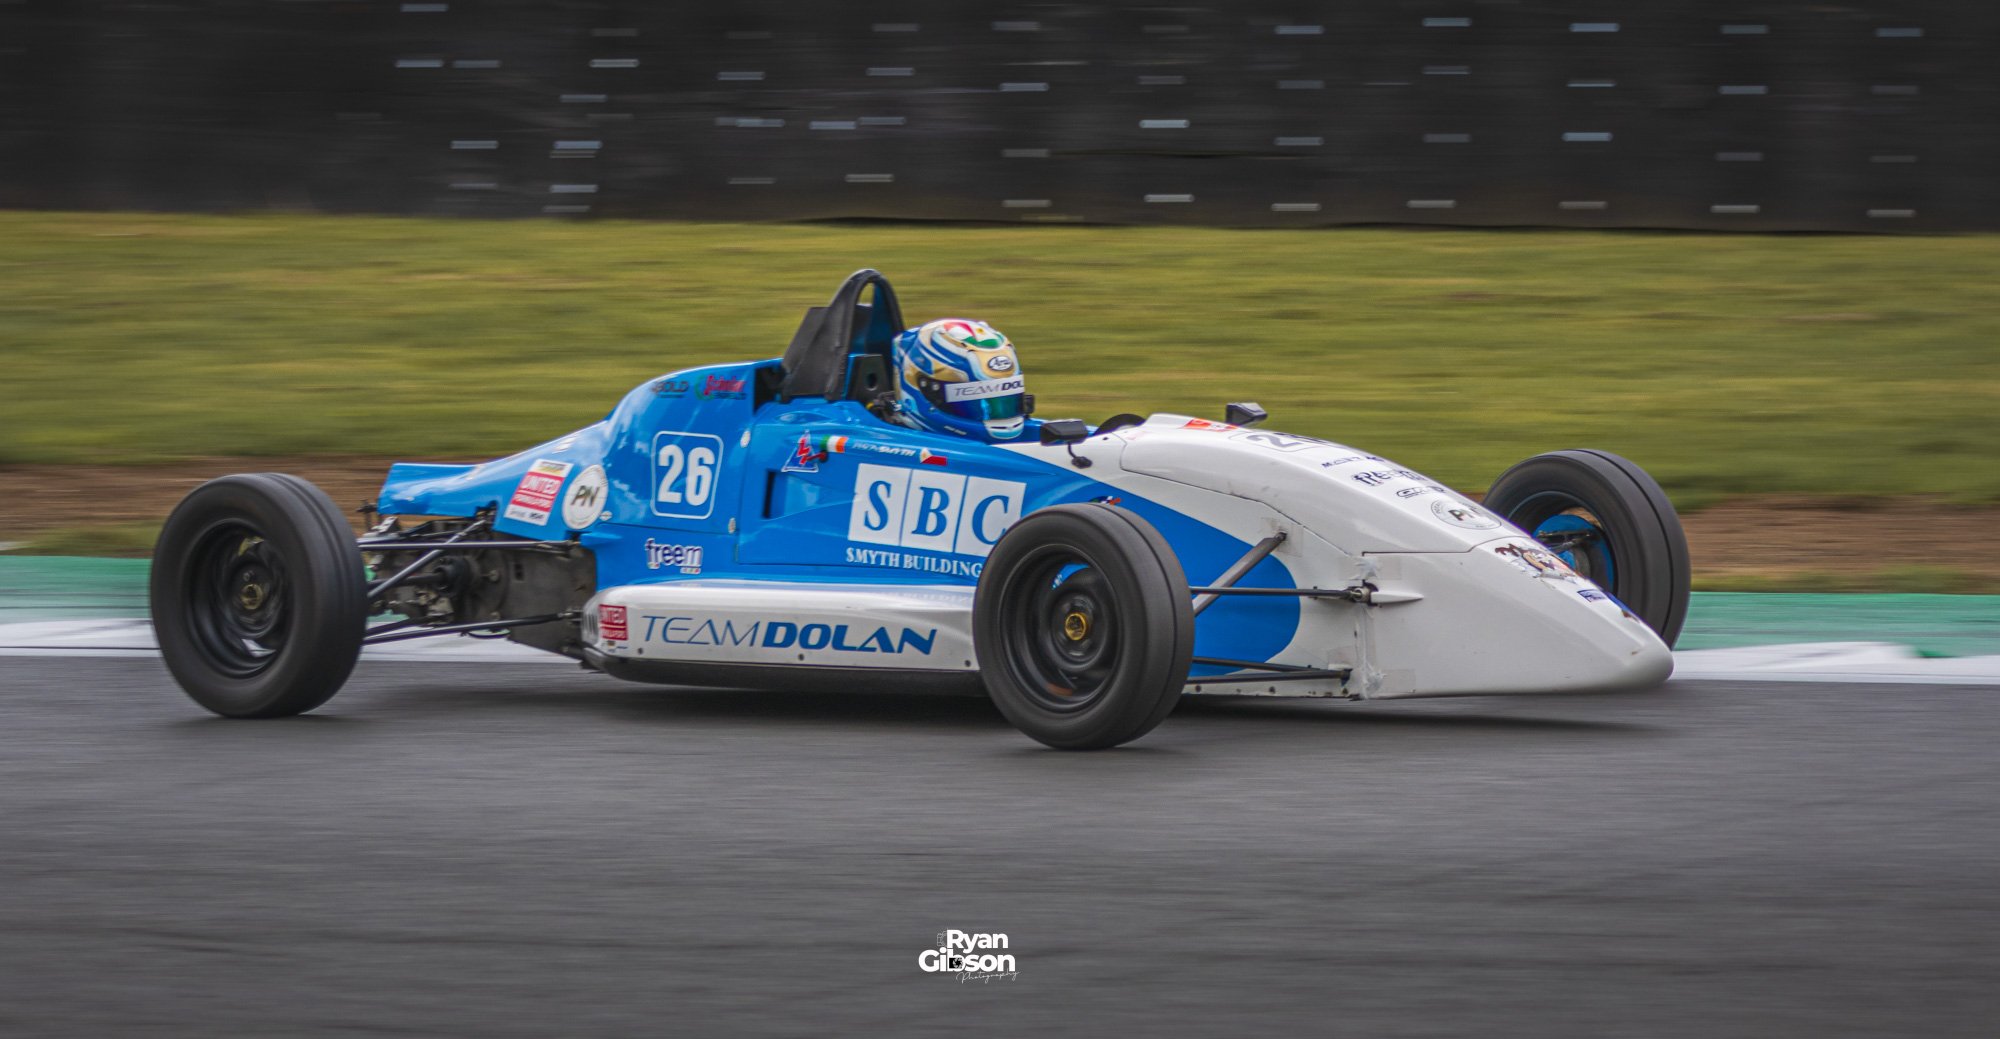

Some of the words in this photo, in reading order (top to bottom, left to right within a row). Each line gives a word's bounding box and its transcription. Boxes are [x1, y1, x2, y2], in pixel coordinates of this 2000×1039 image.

[657, 444, 716, 507] 26
[570, 485, 600, 507] PN
[645, 538, 703, 567] freem
[846, 547, 900, 568] SMYTH
